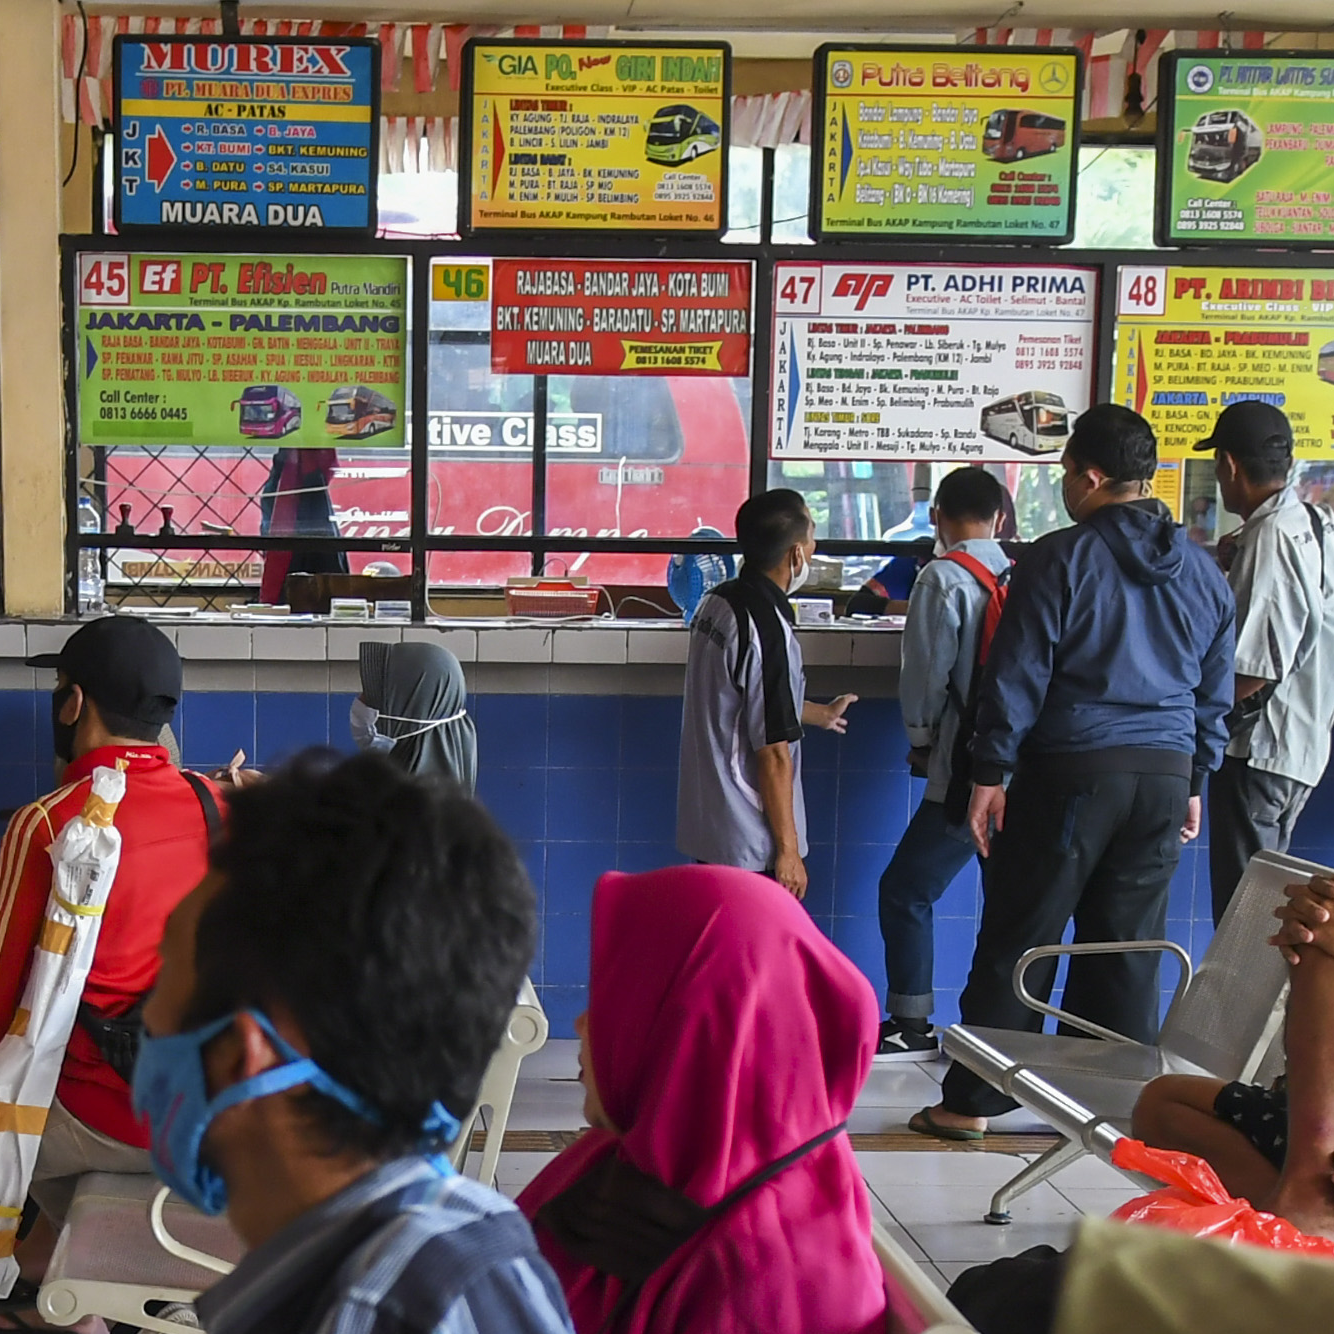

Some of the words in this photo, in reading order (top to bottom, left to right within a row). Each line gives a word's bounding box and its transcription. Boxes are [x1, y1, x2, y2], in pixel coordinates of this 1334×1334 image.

[141, 43, 350, 76] MUREX
[498, 55, 538, 75] GIA
[546, 55, 576, 80] PO.
[579, 55, 611, 71] New
[616, 56, 655, 81] GIRI
[661, 57, 720, 82] INDAH
[546, 83, 588, 92] Executive
[591, 84, 614, 92] Class
[622, 85, 636, 93] VIP
[646, 85, 658, 93] AC
[661, 85, 685, 93] Patas
[694, 86, 718, 94] Toilet
[861, 63, 925, 87] Putra
[932, 63, 1030, 92] Belitang
[164, 80, 189, 98] PT.
[194, 81, 253, 100] MUARA
[256, 83, 287, 100] DUA
[291, 84, 352, 101] EXPRES
[161, 202, 259, 225] MUARA
[267, 205, 323, 227] DUA
[84, 261, 125, 296] 45
[143, 264, 177, 291] Ef
[190, 264, 227, 293] PT.
[237, 262, 327, 294] Efisien
[331, 282, 360, 295] Putra
[363, 282, 400, 295] Mandiri
[442, 268, 484, 298] 46
[517, 271, 575, 295] RAJABASA
[584, 272, 629, 296] BANDAR
[632, 273, 659, 297] JAYA
[669, 273, 698, 297] KOTA
[700, 274, 729, 297] BUMI
[906, 275, 936, 292] PT.
[944, 275, 1003, 293] ADHI
[1011, 276, 1085, 294] PRIMA
[1174, 278, 1211, 299] PT.
[1220, 279, 1303, 301] ARIMBI
[781, 276, 815, 305] 47
[1129, 275, 1157, 306] 48
[86, 314, 205, 330] JAKARTA
[230, 315, 399, 332] PALEMBANG
[497, 306, 521, 330] BKT.
[524, 307, 584, 331] KEMUNING
[593, 308, 651, 333] BARADATU
[660, 309, 676, 333] SP.
[679, 309, 747, 333] MARTAPURA
[1155, 331, 1211, 345] JAKARTA
[1224, 332, 1309, 346] PRABUMULIH
[527, 341, 566, 365] MUARA
[569, 342, 591, 365] DUA
[100, 391, 121, 403] Call
[124, 392, 159, 404] Center
[100, 407, 127, 419] 0813
[130, 408, 158, 420] 6666
[160, 408, 187, 420] 0445
